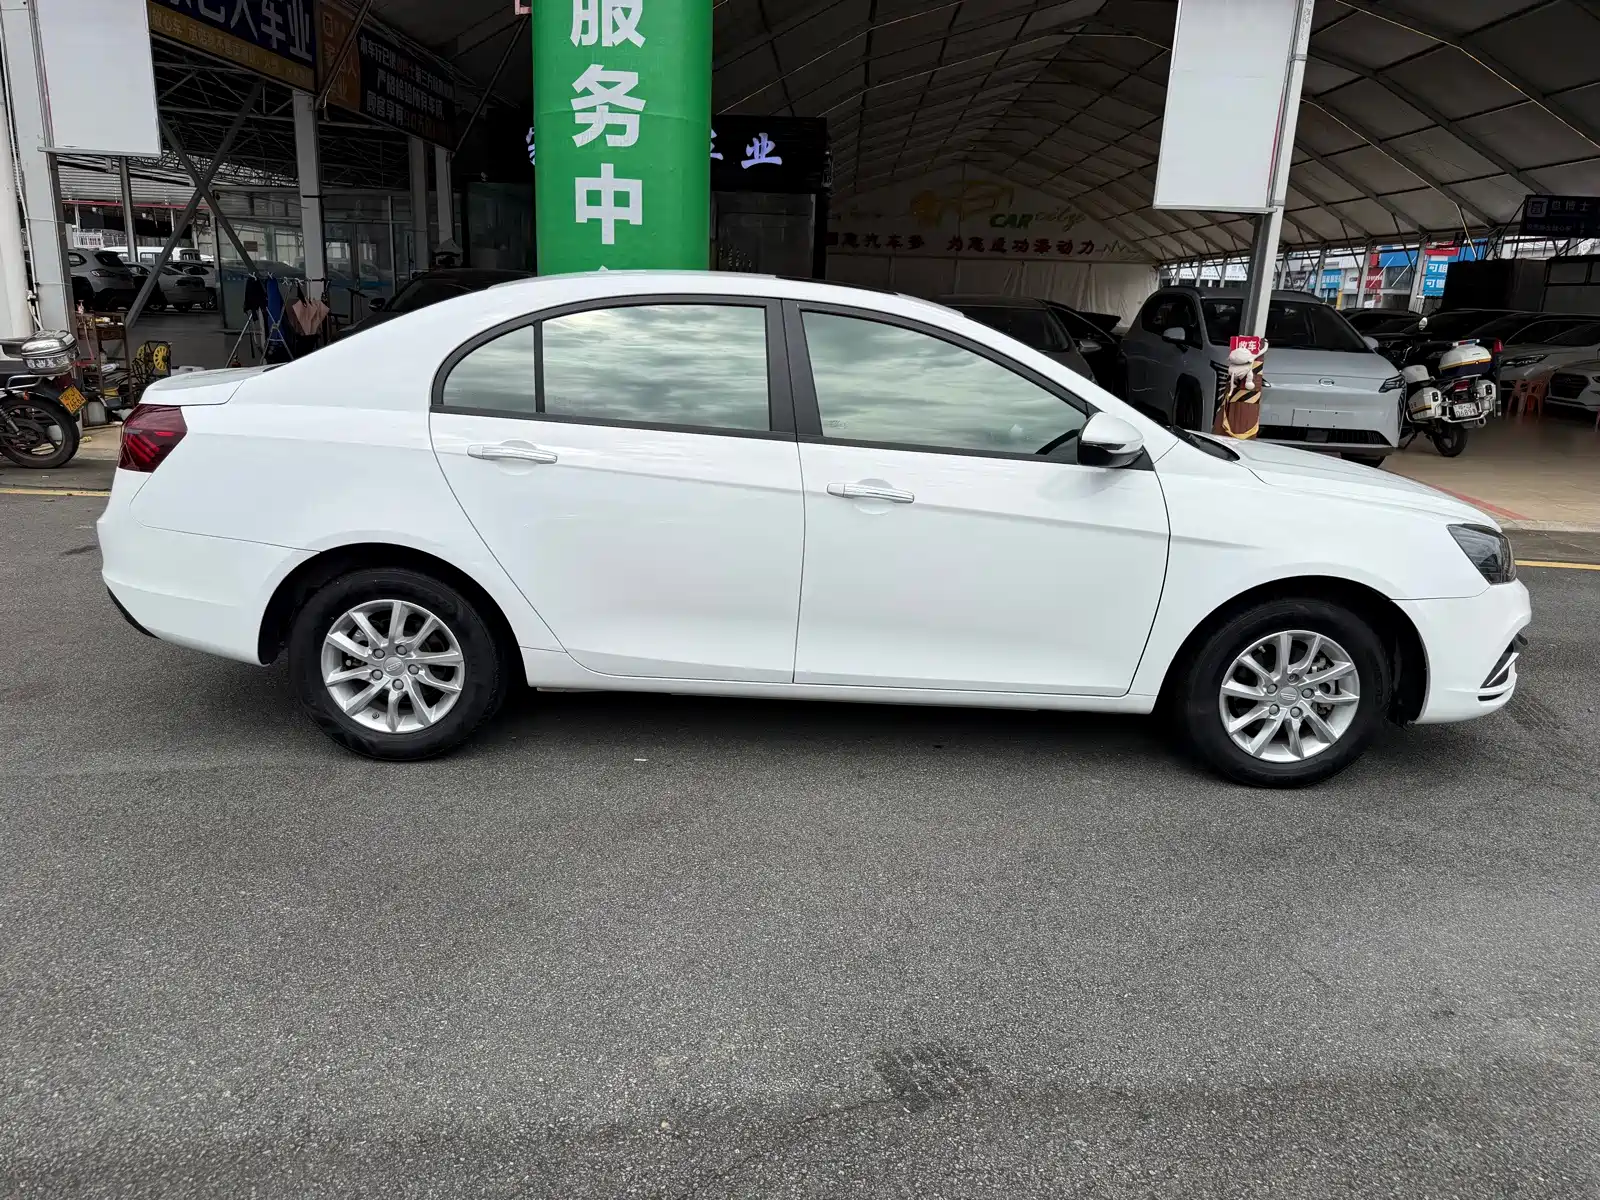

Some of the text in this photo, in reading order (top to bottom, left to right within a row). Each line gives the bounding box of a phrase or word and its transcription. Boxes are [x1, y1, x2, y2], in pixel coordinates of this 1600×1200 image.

[570, 0, 647, 271] 服务中
[989, 213, 1034, 229] CAR
